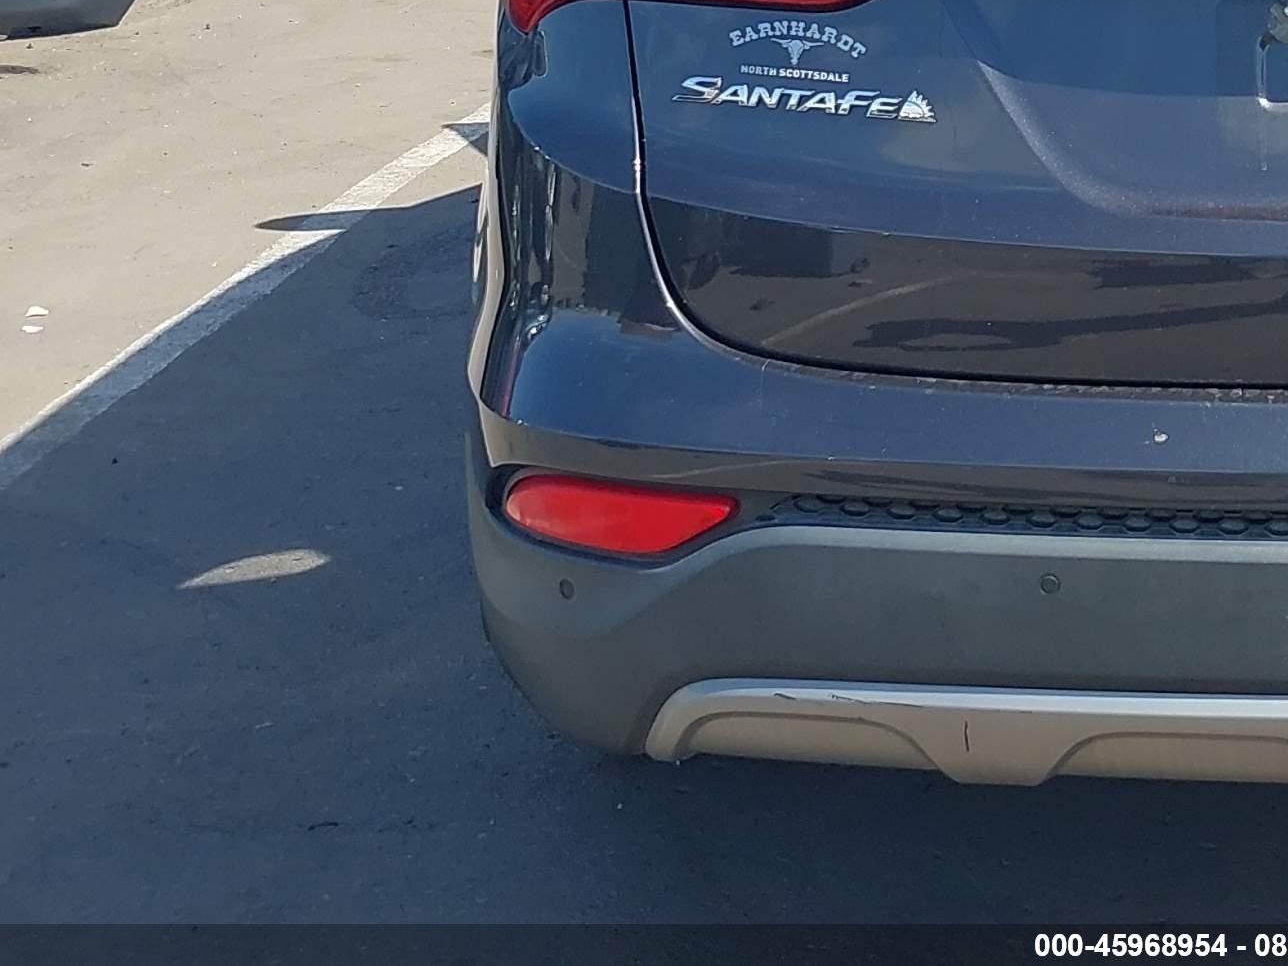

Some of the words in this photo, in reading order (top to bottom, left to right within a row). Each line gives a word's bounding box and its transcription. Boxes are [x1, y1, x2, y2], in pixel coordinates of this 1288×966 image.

[729, 20, 866, 59] EARNHARDT
[740, 64, 777, 76] NORTH
[779, 67, 849, 83] SCOTTSDALE
